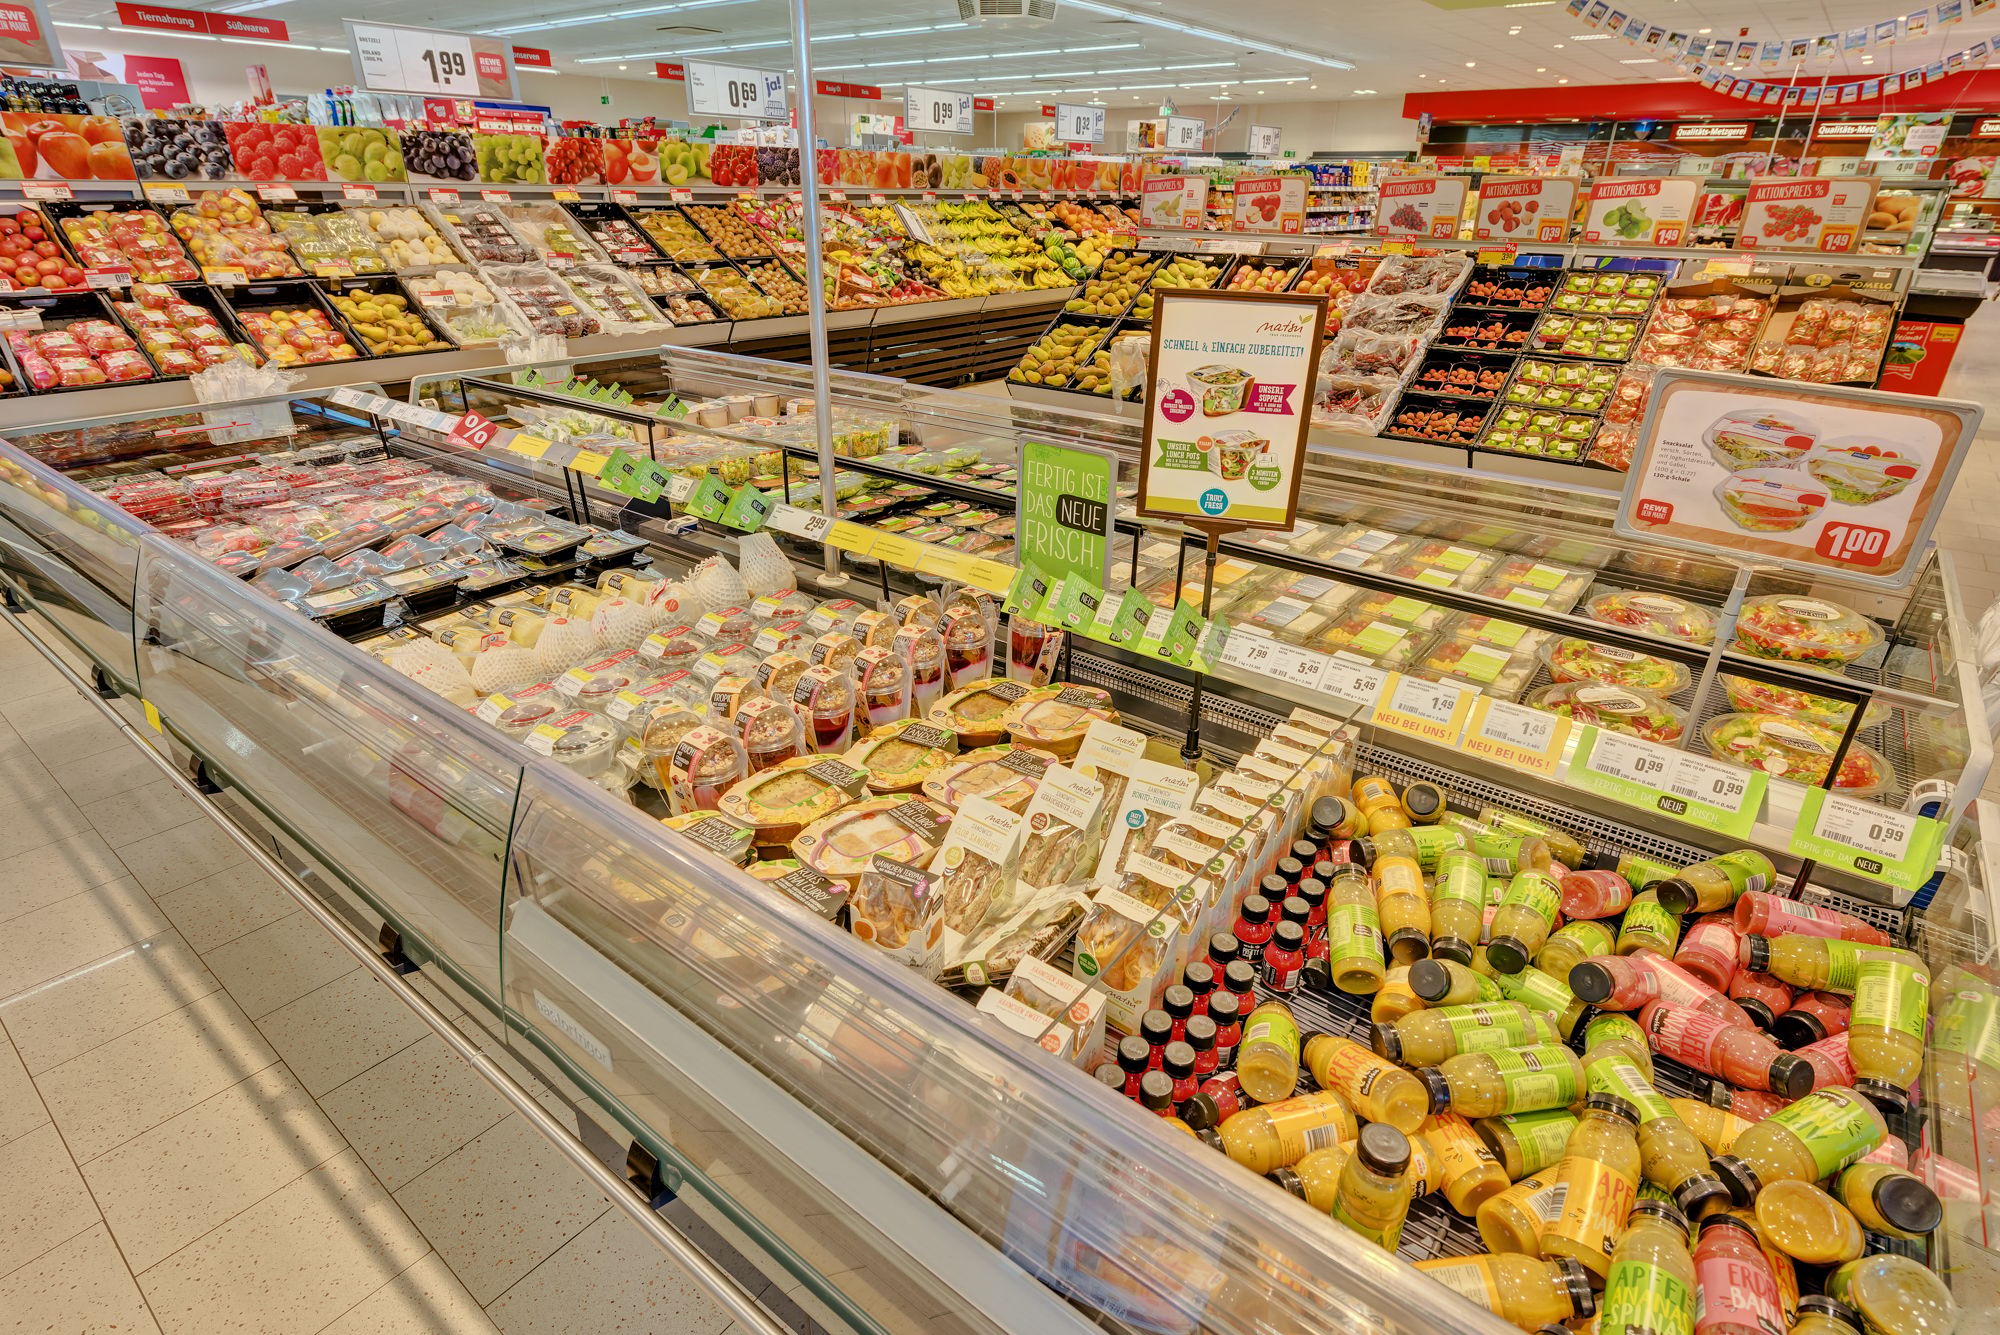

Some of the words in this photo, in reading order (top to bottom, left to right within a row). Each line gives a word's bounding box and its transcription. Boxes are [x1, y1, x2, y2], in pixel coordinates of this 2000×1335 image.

[136, 10, 195, 28] Tiernahrung
[225, 20, 270, 34] Süßwaren
[479, 57, 502, 67] REWE
[512, 52, 540, 61] onserven
[421, 49, 466, 85] 1.99
[728, 80, 757, 108] 0.69
[765, 76, 782, 98] ja!
[933, 101, 953, 125] 0.99
[1676, 124, 1747, 139] Qualitäts-Metzgerei
[1147, 181, 1175, 193] AKTIONSPREIS
[1176, 181, 1183, 189] %
[1239, 180, 1271, 193] AKTIONSPREIS
[1272, 180, 1279, 191] %
[1385, 182, 1424, 196] AKTIONSPREIS
[1425, 183, 1432, 193] %
[1485, 183, 1529, 197] AKTIONSPREIS
[1531, 183, 1538, 194] %
[1598, 184, 1646, 198] AKTIONSPREIS
[1648, 183, 1656, 194] %
[1756, 183, 1810, 200] AKTIONSPREIS
[1815, 184, 1824, 196] %
[1434, 224, 1452, 239] 3.49
[1540, 226, 1560, 242] 0.39
[1658, 229, 1679, 245] 1.49
[1505, 243, 1517, 252] %
[1824, 235, 1849, 251] 1.49
[115, 272, 130, 283] 0.99
[1732, 277, 1773, 286] POMELO
[1849, 281, 1893, 290] POMELO
[1257, 319, 1304, 335] natsu
[1163, 339, 1200, 352] SCHNELL
[1202, 342, 1209, 352] &
[1211, 341, 1246, 354] EINFACH
[1248, 343, 1305, 358] ZUBEREITET!
[1258, 385, 1285, 394] UNSERE
[669, 399, 679, 411] NEUE
[1258, 394, 1283, 403] SUPPEN
[463, 415, 491, 444] %
[1166, 442, 1191, 451] UNSERE
[1662, 439, 1694, 449] Snacksalat
[1166, 451, 1183, 459] LUNCH
[1185, 452, 1200, 460] POTS
[1660, 447, 1681, 455] versch.
[1682, 449, 1704, 458] Sorten,
[1669, 454, 1716, 467] Joghurtdressing
[1669, 461, 1688, 469] Gabel,
[1027, 460, 1075, 494] FERTIG
[1081, 472, 1104, 500] IST
[1257, 470, 1278, 478] MINUTEN
[1653, 472, 1691, 483] 130-g-Schale
[1204, 501, 1223, 510] FRESH
[1205, 494, 1224, 502] TRULY
[1026, 489, 1054, 519] DAS
[1061, 498, 1103, 531] NEUE
[1641, 510, 1652, 518] DEIN
[1652, 512, 1667, 521] MARKT
[1642, 502, 1669, 514] REWE
[803, 515, 827, 532] 2.99
[1024, 519, 1099, 570] FRISCH.
[1827, 525, 1884, 560] 1.00
[1247, 646, 1268, 660] 7.99
[588, 659, 610, 671] FRISCH
[1297, 661, 1319, 675] 5.49
[516, 686, 540, 697] FRISCH
[638, 684, 663, 696] FRISCH
[1353, 678, 1376, 692] 5.49
[1431, 696, 1455, 711] 1.49
[555, 713, 582, 725] FRISCH
[1376, 711, 1400, 726] NEU
[1402, 719, 1420, 732] BEI
[1423, 725, 1446, 739] UNS
[1521, 721, 1547, 737] 1.49
[1012, 750, 1035, 763] ROTES
[1466, 739, 1492, 753] NEU
[1495, 747, 1514, 760] BEI
[1517, 752, 1543, 768] UNS
[1005, 755, 1022, 766] THAI
[1021, 760, 1047, 773] CURRY
[1634, 757, 1664, 774] 0.99
[1160, 775, 1190, 788] natsu
[1713, 779, 1744, 796] 0.99
[1068, 782, 1095, 797] natsu
[907, 800, 933, 815] ROTES
[1131, 790, 1182, 811] BONITO-THUNFISCH
[1625, 787, 1637, 797] IST
[1640, 792, 1657, 804] DAS
[1660, 798, 1686, 814] NEUE
[1832, 800, 1858, 811] SMOOTHIE
[898, 804, 914, 818] THAI
[911, 811, 939, 829] CURRY
[984, 814, 1013, 831] natsu
[1868, 823, 1904, 843] 0.99
[1795, 840, 1820, 854] FERTIG
[1823, 848, 1836, 858] IST
[1839, 852, 1854, 865] DAS
[1856, 858, 1881, 873] NEUE
[1851, 841, 1864, 849] 100
[1878, 849, 1897, 859] 0.40€
[875, 859, 904, 876] HÄHNCHEN
[799, 868, 825, 885] ROTES
[785, 872, 804, 889] THAI
[801, 881, 832, 901] CURRY
[1105, 989, 1137, 1009] natsu
